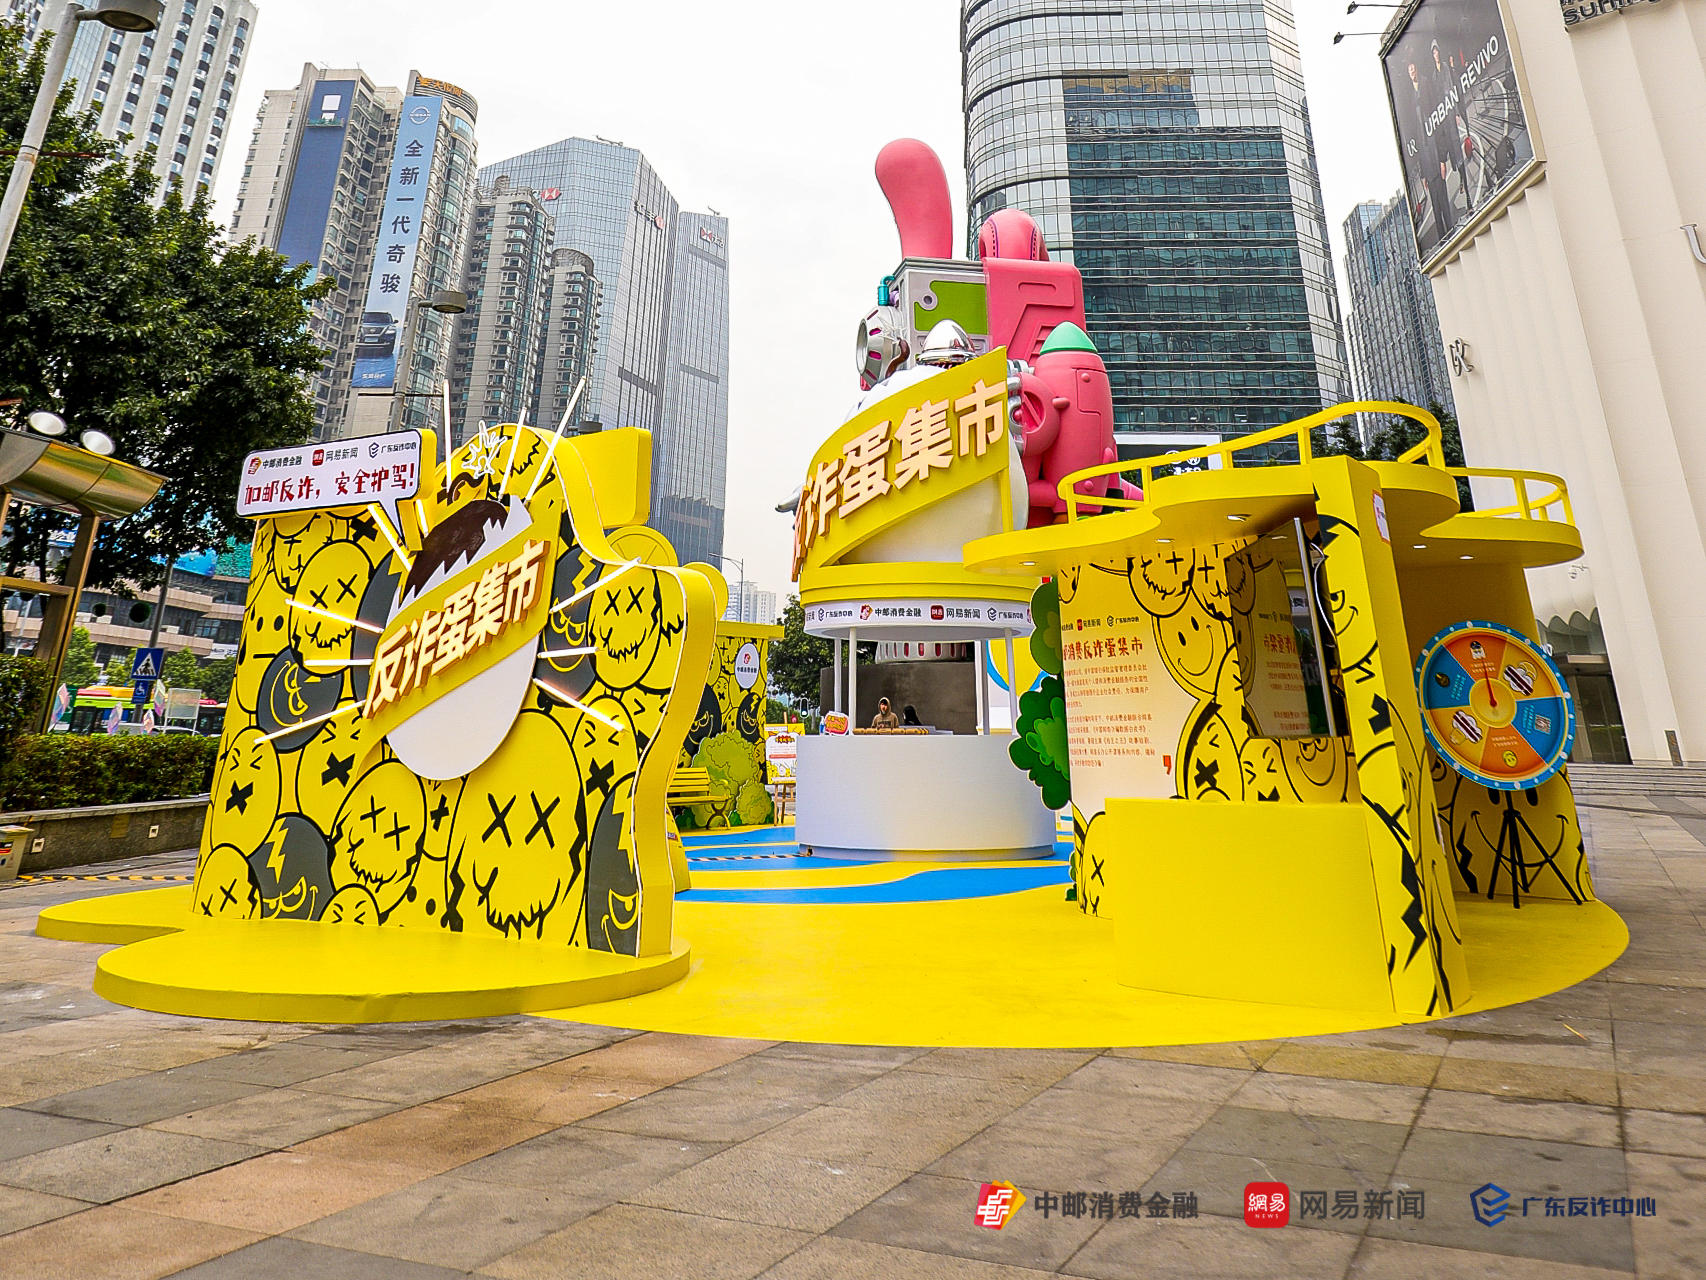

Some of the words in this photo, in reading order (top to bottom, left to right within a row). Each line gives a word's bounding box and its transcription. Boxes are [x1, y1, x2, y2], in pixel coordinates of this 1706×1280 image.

[1424, 85, 1459, 137] URBAN
[1460, 35, 1499, 93] REVIVO
[380, 139, 424, 294] 全新一代奇骏
[362, 539, 551, 720] 反诈蛋集市
[874, 607, 922, 618] 中邮消费金融
[946, 608, 980, 619] 网易新闻
